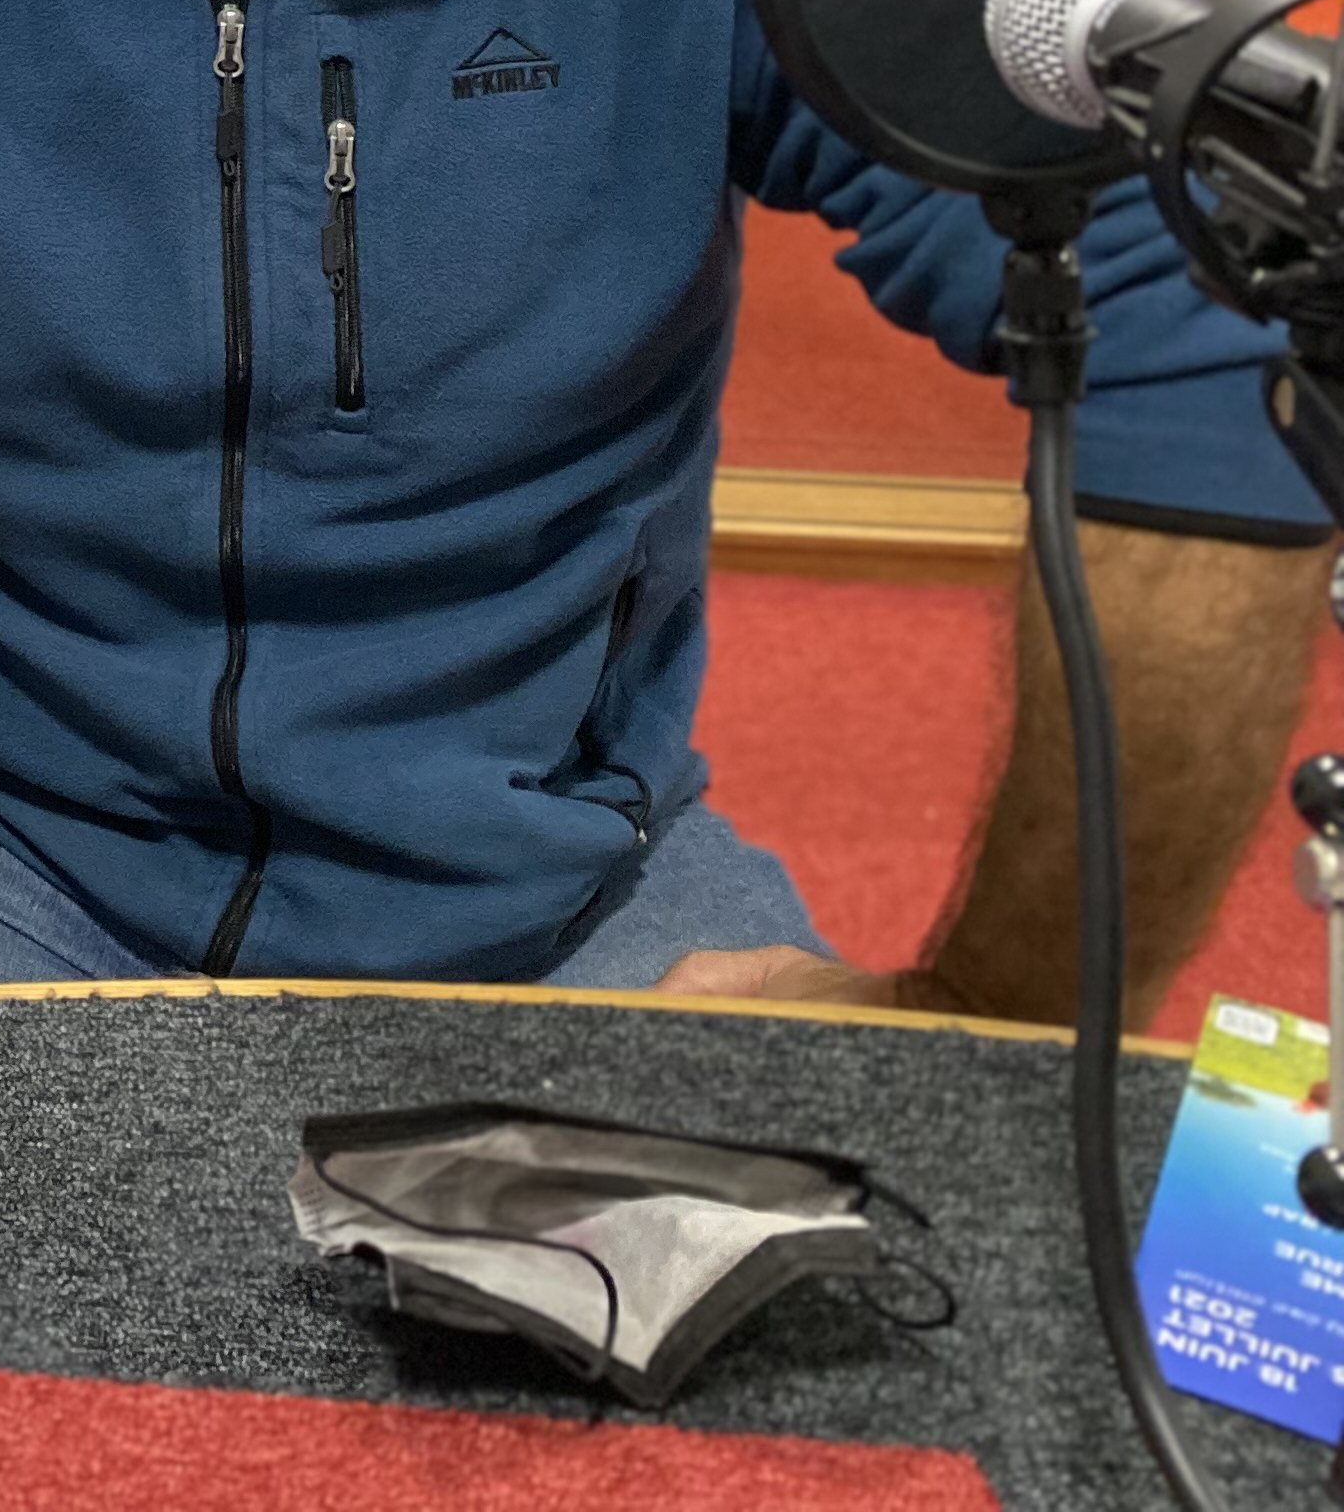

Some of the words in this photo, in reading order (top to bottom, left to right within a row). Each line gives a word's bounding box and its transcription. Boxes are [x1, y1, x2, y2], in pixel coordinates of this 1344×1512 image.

[1168, 1285, 1258, 1329] 2021
[1157, 1328, 1251, 1373] JUIN
[1162, 1308, 1321, 1373] JUILLET
[1259, 1363, 1299, 1394] 18
